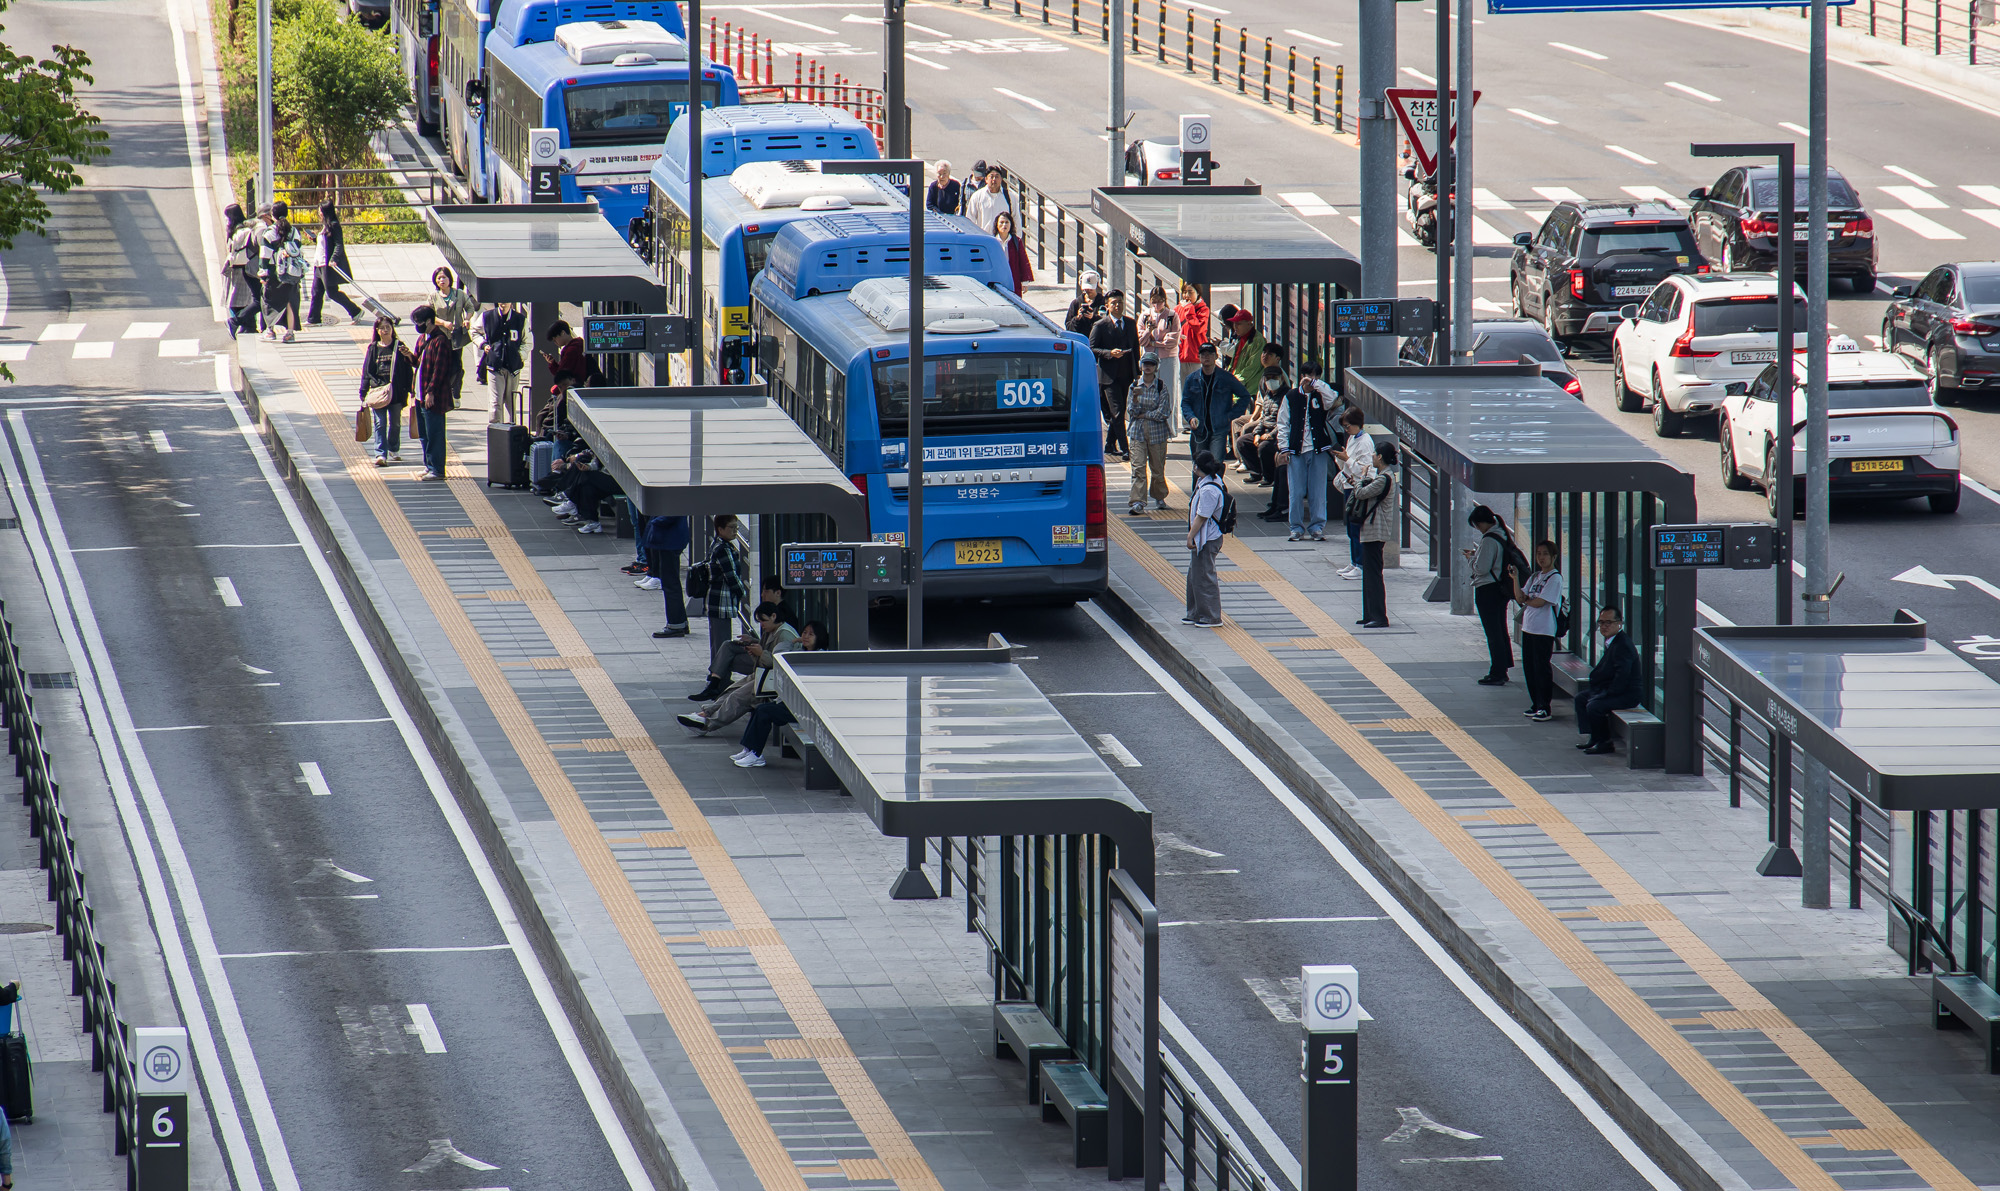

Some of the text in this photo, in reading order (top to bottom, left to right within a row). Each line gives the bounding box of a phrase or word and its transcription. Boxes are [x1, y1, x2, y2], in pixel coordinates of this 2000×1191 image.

[1410, 101, 1455, 117] 천천
[1190, 157, 1204, 175] 4
[540, 172, 551, 190] 5
[631, 184, 649, 194] 선진
[1338, 305, 1379, 315] 152 162
[590, 321, 632, 331] 104 701
[510, 329, 519, 341] D
[1003, 381, 1046, 406] 503
[937, 448, 957, 460] 판매
[958, 447, 972, 458] 1위
[974, 444, 1024, 458] 탈모치료제
[1027, 443, 1057, 456] 로게인
[1059, 443, 1069, 455] 폼
[1878, 460, 1901, 470] 5641
[921, 470, 1033, 485] HYUNDAI
[957, 487, 1000, 499] 보영운수
[1054, 526, 1069, 534] 주의
[1660, 532, 1708, 543] 152 162
[789, 551, 838, 562] 104 701
[957, 549, 1000, 562] 사2923
[833, 569, 849, 577] 9200
[1323, 1044, 1344, 1075] 5
[152, 1106, 174, 1138] 6
